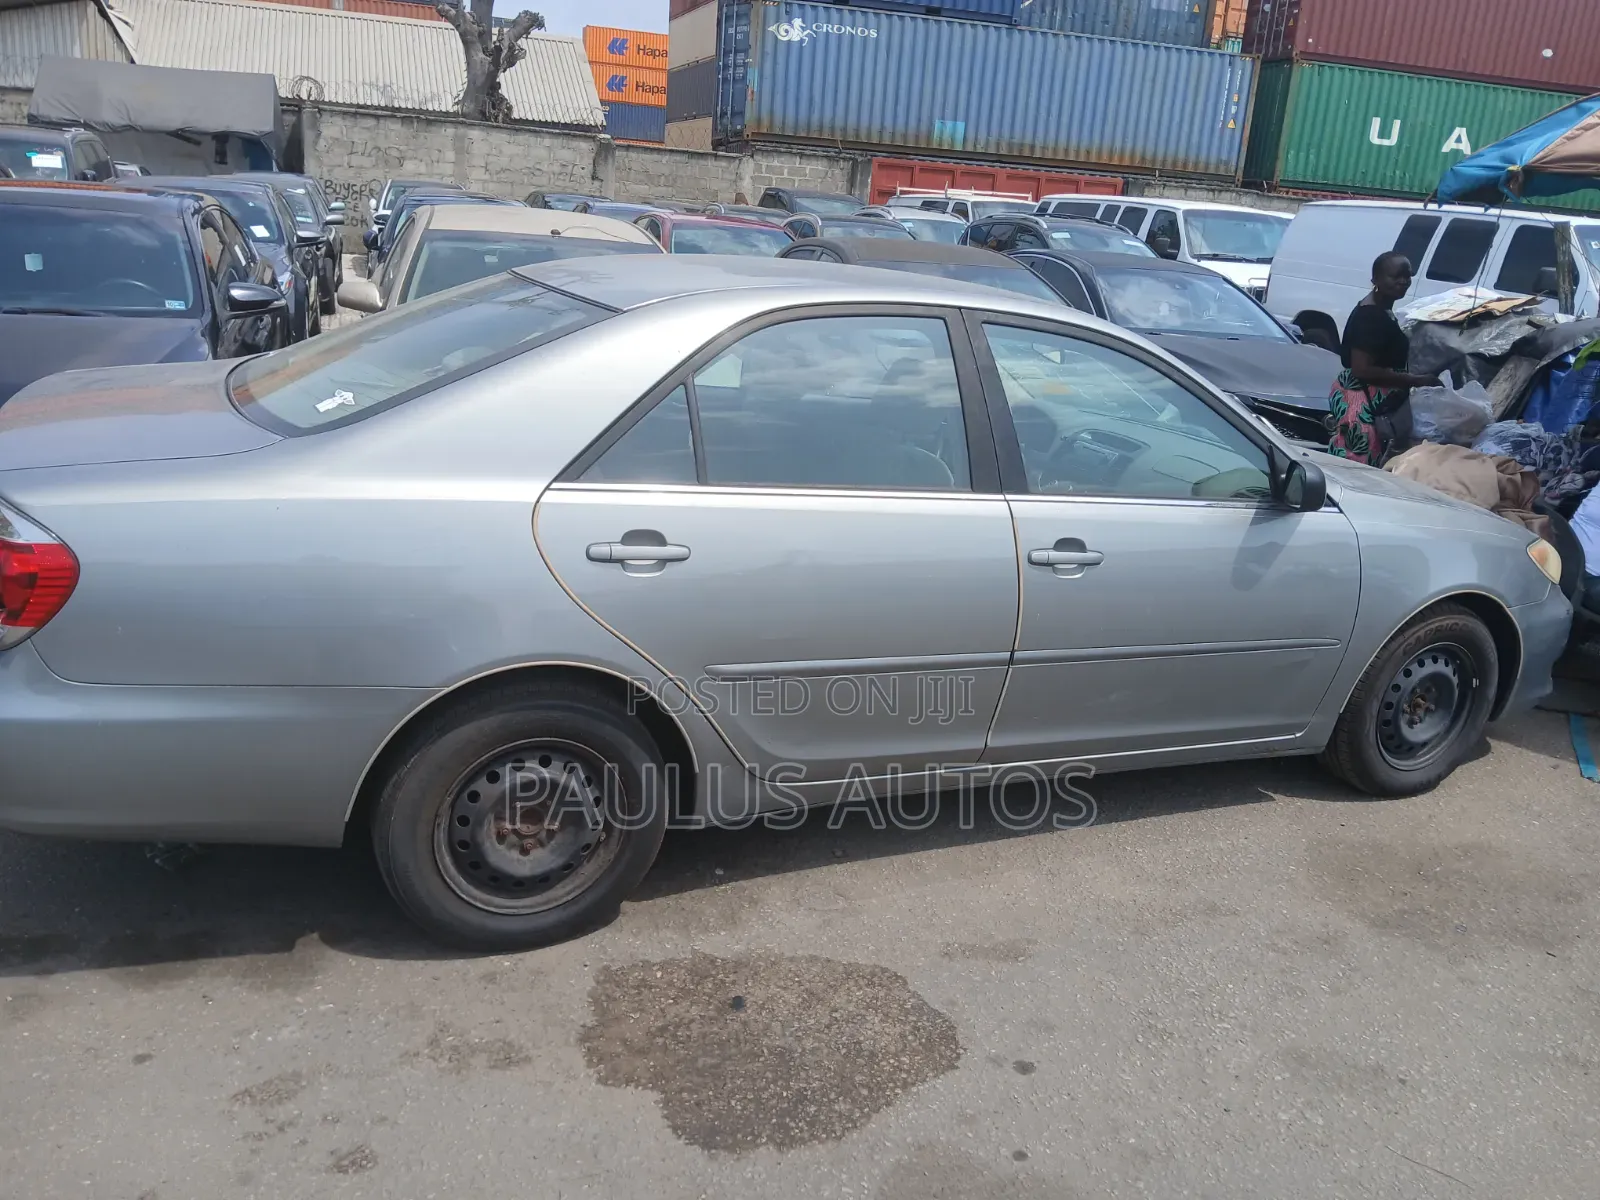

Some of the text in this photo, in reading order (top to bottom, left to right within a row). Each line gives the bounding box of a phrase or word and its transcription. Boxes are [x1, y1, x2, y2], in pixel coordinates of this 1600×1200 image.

[812, 22, 878, 38] CRONOS
[636, 44, 668, 59] Hapa
[635, 80, 667, 95] Hapa
